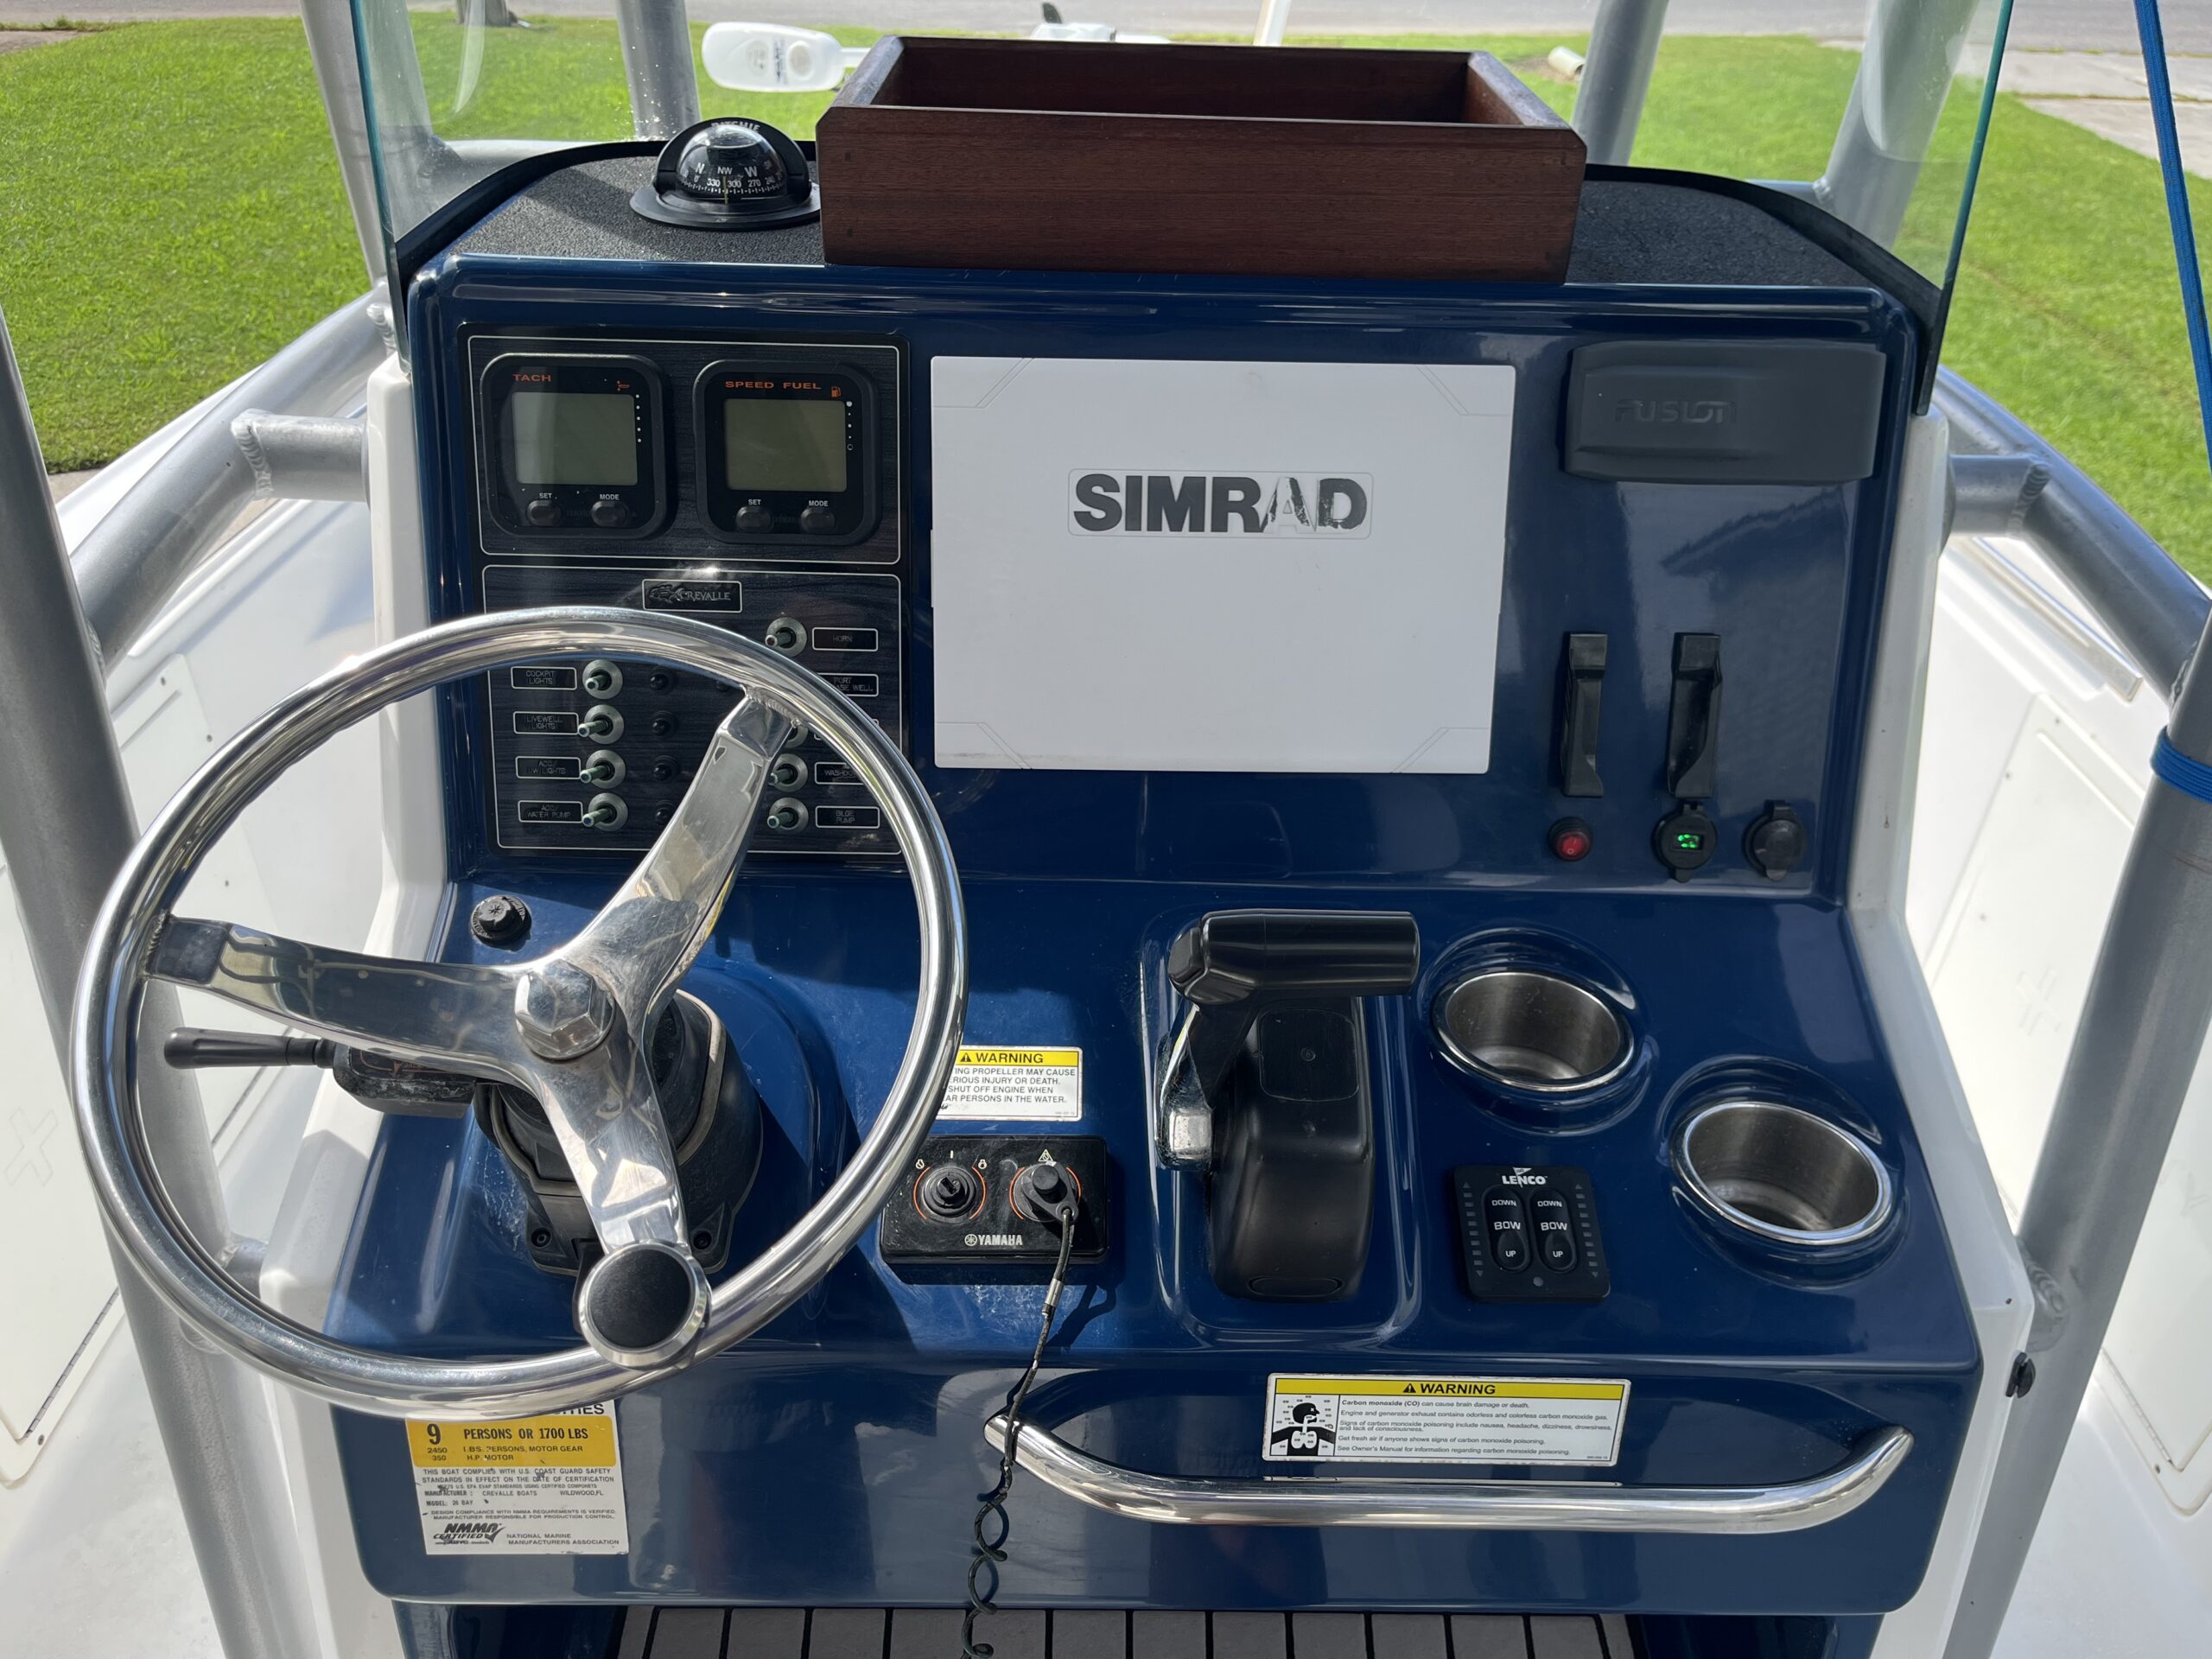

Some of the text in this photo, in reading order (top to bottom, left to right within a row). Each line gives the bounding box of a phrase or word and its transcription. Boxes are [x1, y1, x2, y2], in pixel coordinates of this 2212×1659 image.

[717, 166, 733, 175] NW
[744, 166, 758, 178] W
[707, 178, 761, 188] 330 300 270
[512, 373, 551, 382] TACH
[1615, 398, 1737, 423] FUSION
[1073, 473, 1368, 534] SIMRAD
[680, 590, 731, 601] CREVALLE
[976, 1052, 1044, 1064] WARNING
[1502, 1175, 1547, 1187] LENCO
[1494, 1221, 1521, 1230] BOW
[1541, 1221, 1567, 1231] BOW
[978, 1234, 1023, 1246] YAMAHA
[1421, 1383, 1496, 1395] WARNING
[427, 1423, 588, 1445] 9 PERSONS OR 1700 LBS
[444, 1522, 499, 1533] NMMA
